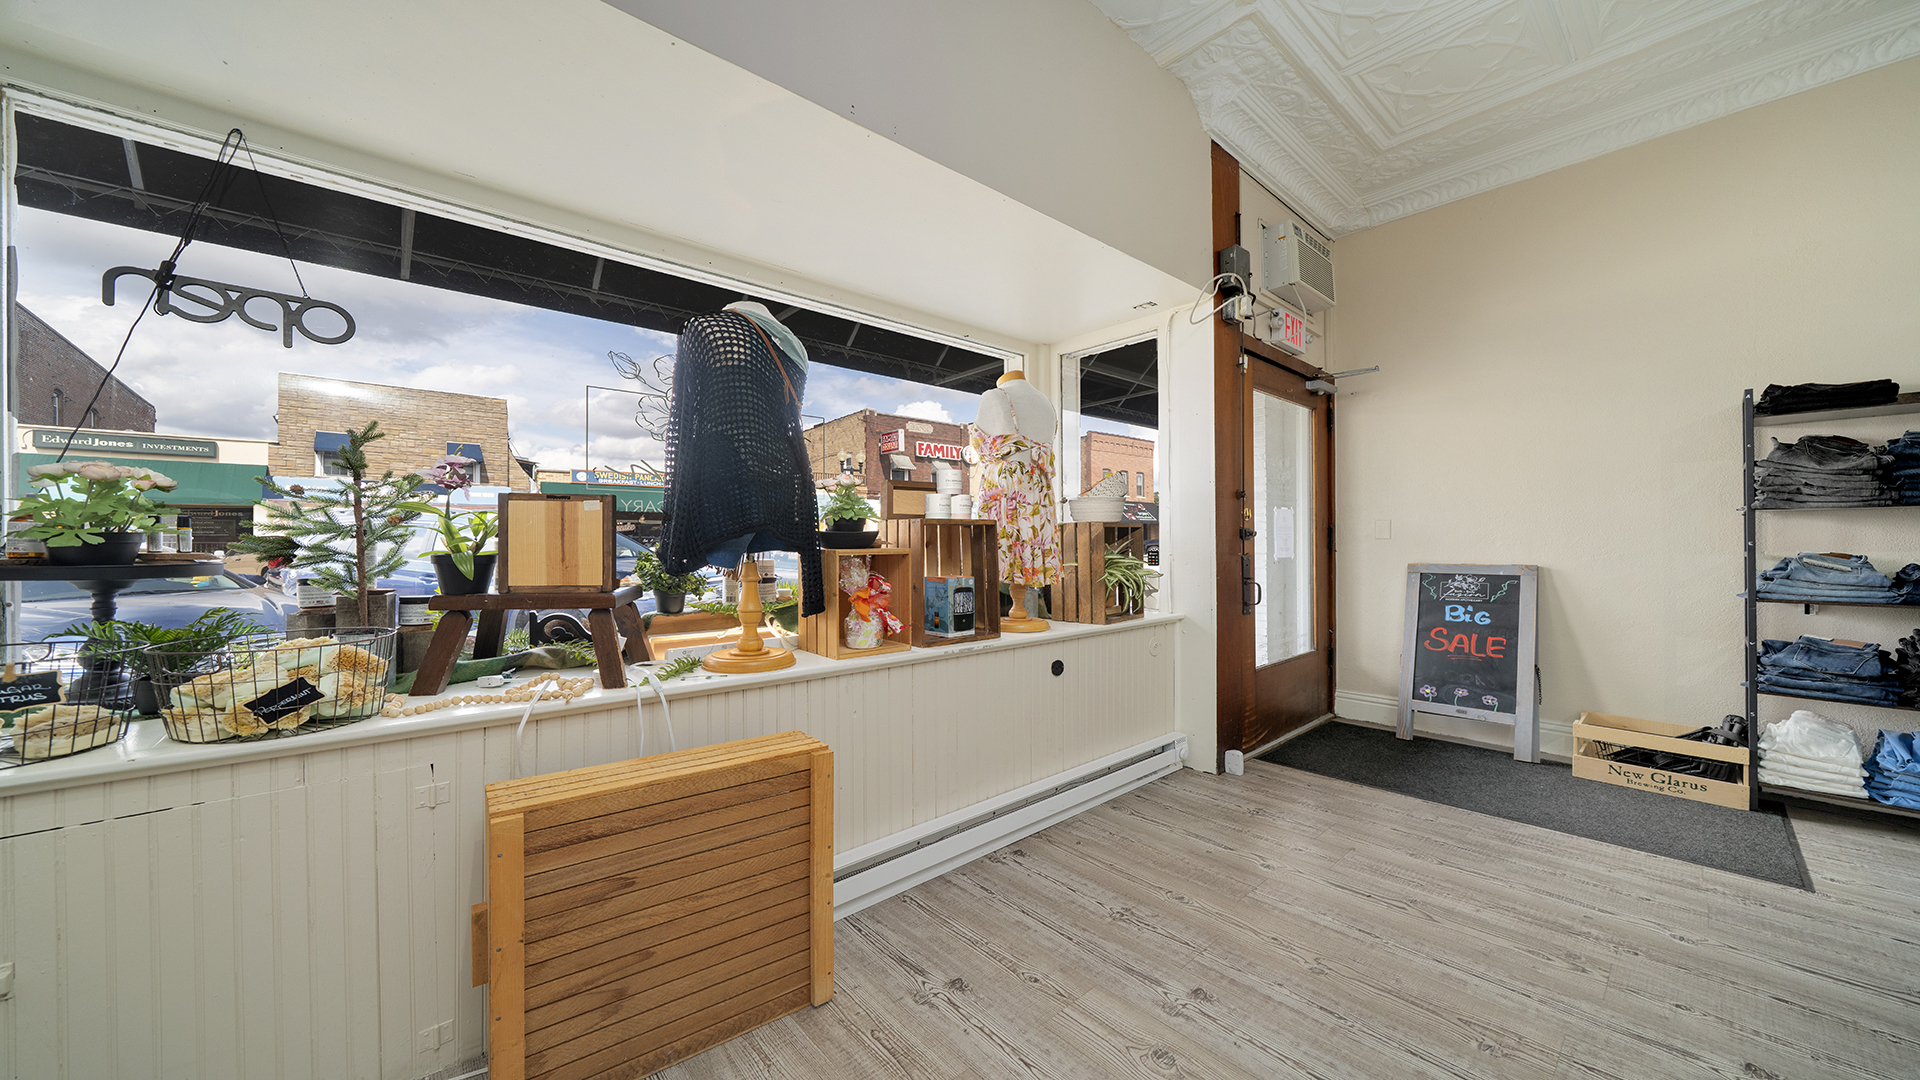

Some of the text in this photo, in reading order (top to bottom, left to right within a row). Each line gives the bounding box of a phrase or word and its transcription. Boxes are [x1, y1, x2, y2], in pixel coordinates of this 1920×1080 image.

[1285, 312, 1303, 348] EXIT
[142, 443, 209, 453] INVESTMENTS
[917, 442, 962, 460] FAMILY
[594, 471, 665, 482] SWEDISH PANCAK
[1424, 627, 1507, 659] SALE
[0, 692, 48, 704] TRUS
[1607, 764, 1708, 792] New Glarus
[1626, 778, 1687, 796] Brewing Co.
